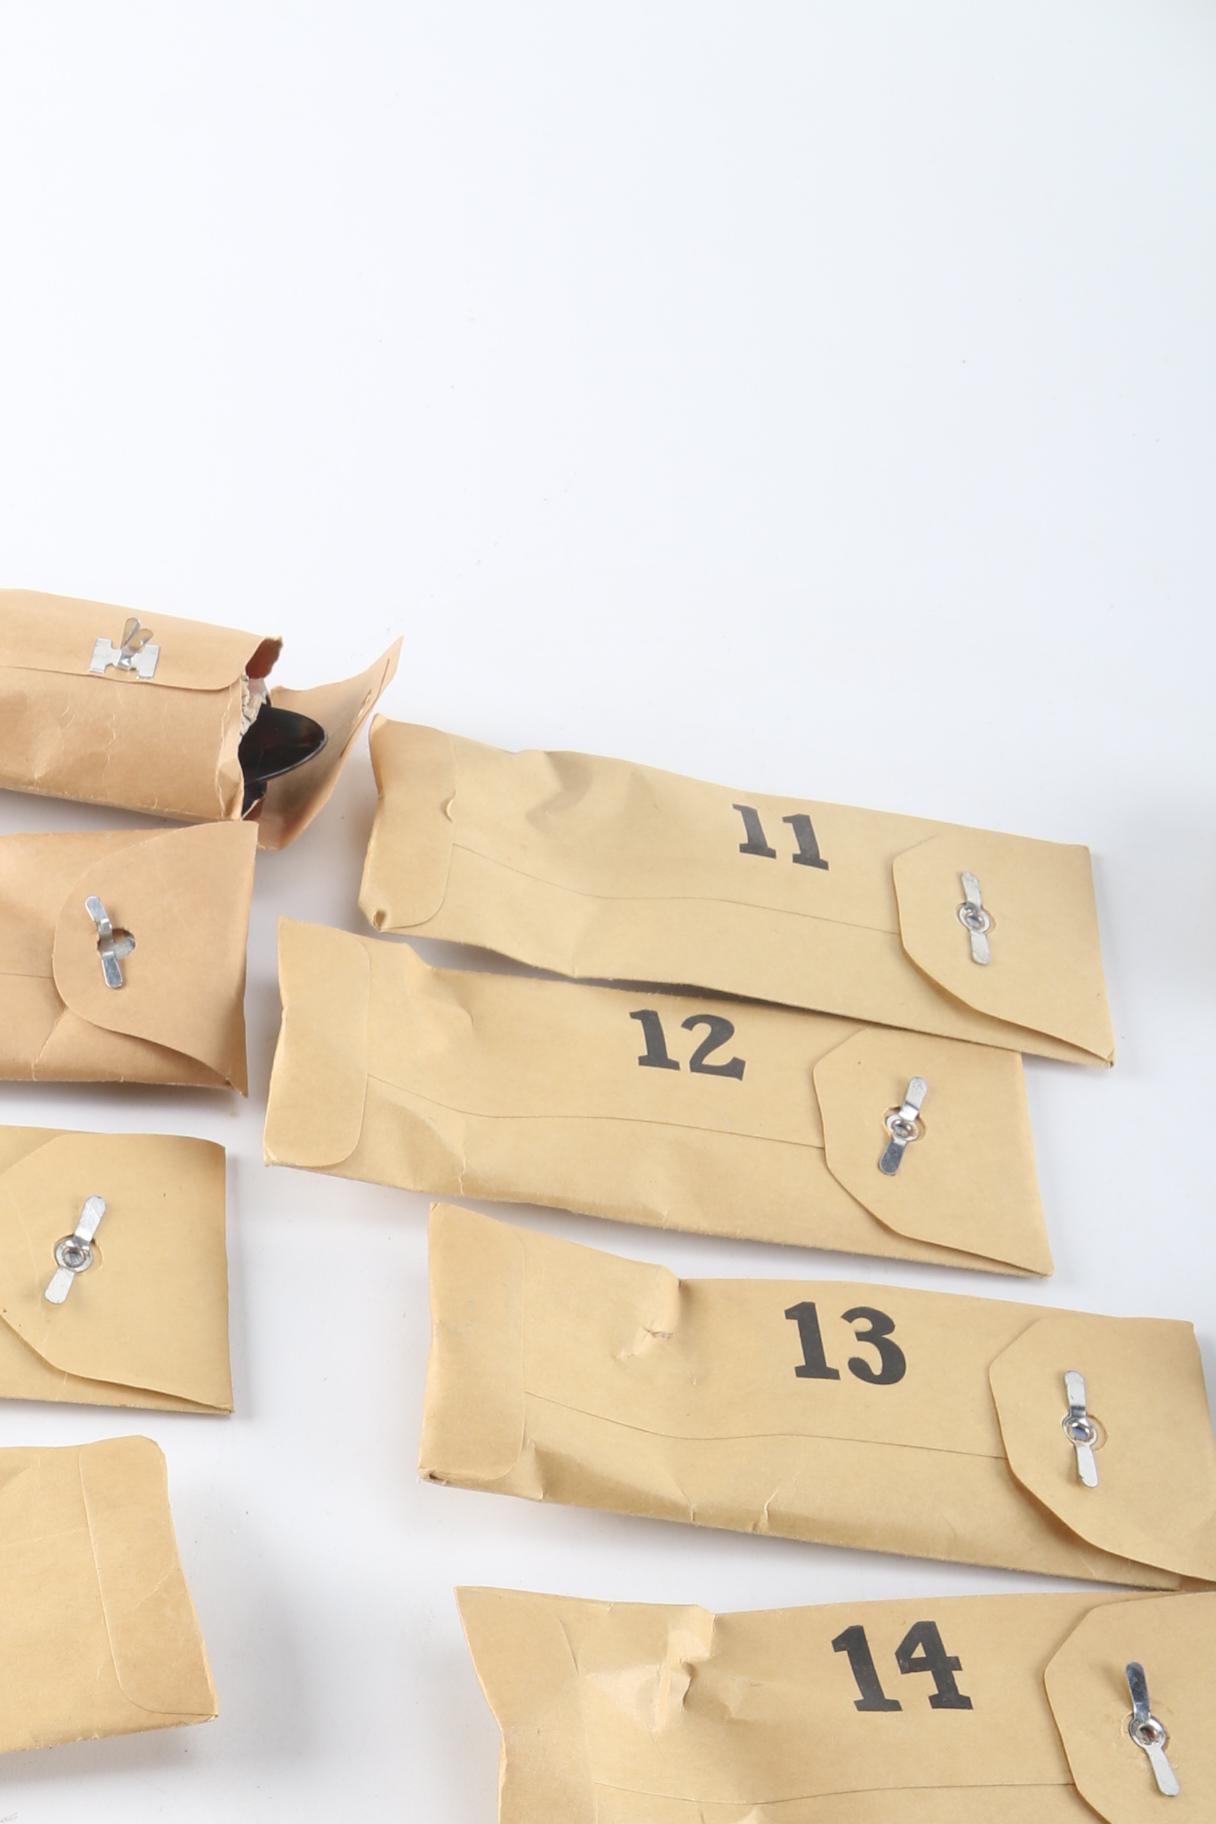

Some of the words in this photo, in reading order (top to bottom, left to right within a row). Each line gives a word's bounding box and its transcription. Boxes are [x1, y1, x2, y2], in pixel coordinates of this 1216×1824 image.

[732, 803, 830, 870] 11
[630, 1009, 746, 1081] 12
[784, 1301, 907, 1385] 13
[831, 1620, 973, 1712] 14
